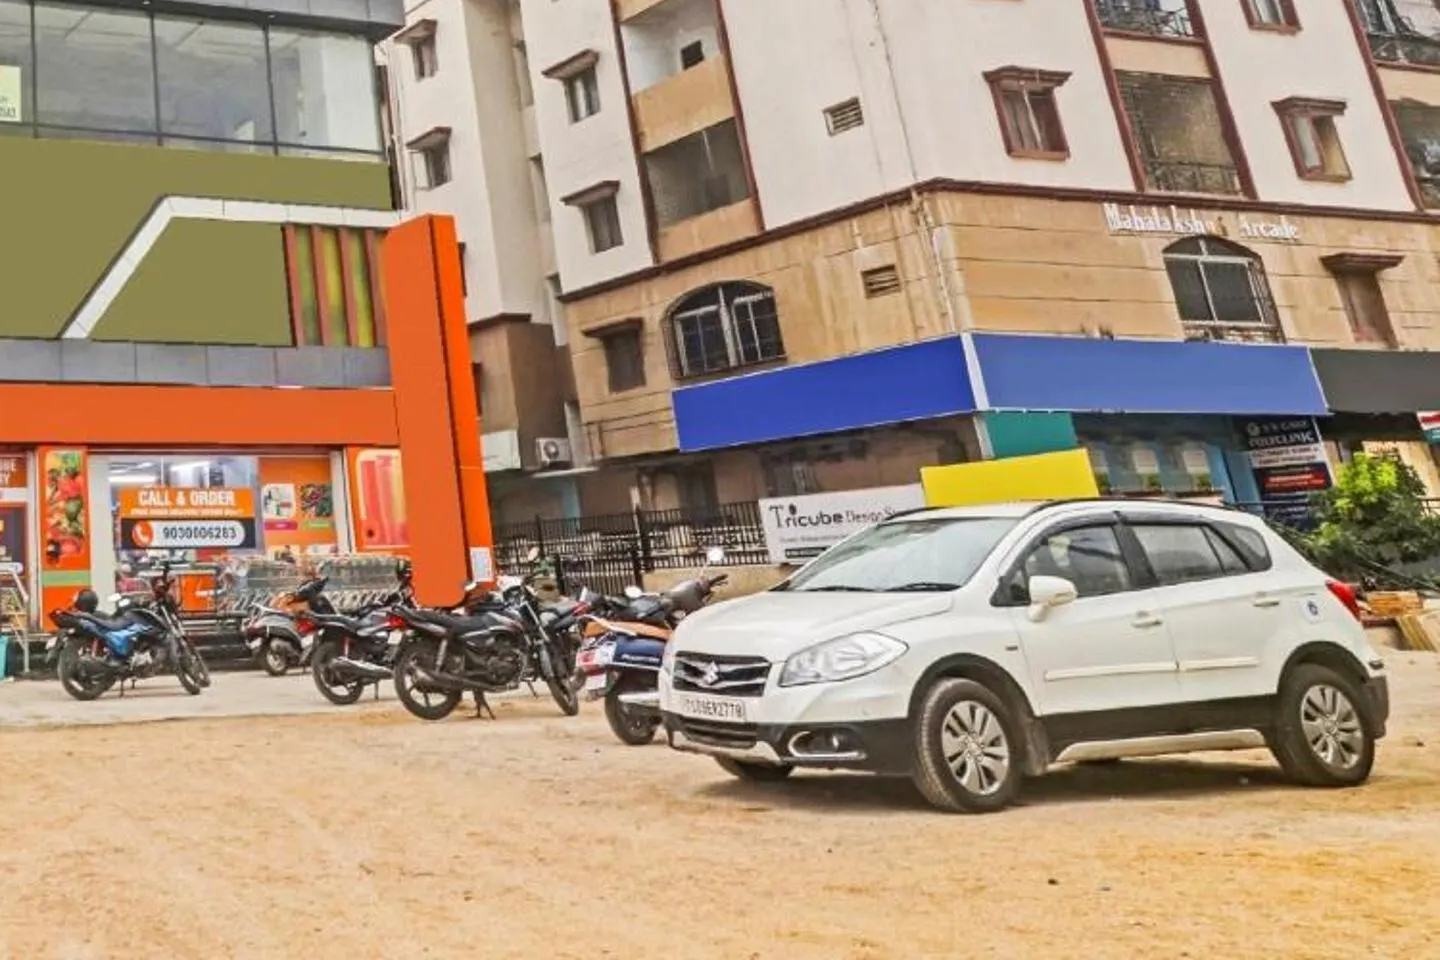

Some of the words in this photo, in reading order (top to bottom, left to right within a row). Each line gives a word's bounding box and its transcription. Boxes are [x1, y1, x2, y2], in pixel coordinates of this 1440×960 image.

[1103, 202, 1227, 236] Mahalaksh
[138, 489, 171, 506] CALL
[175, 490, 186, 506] &
[189, 490, 236, 506] ORDER
[769, 503, 843, 528] Tricube
